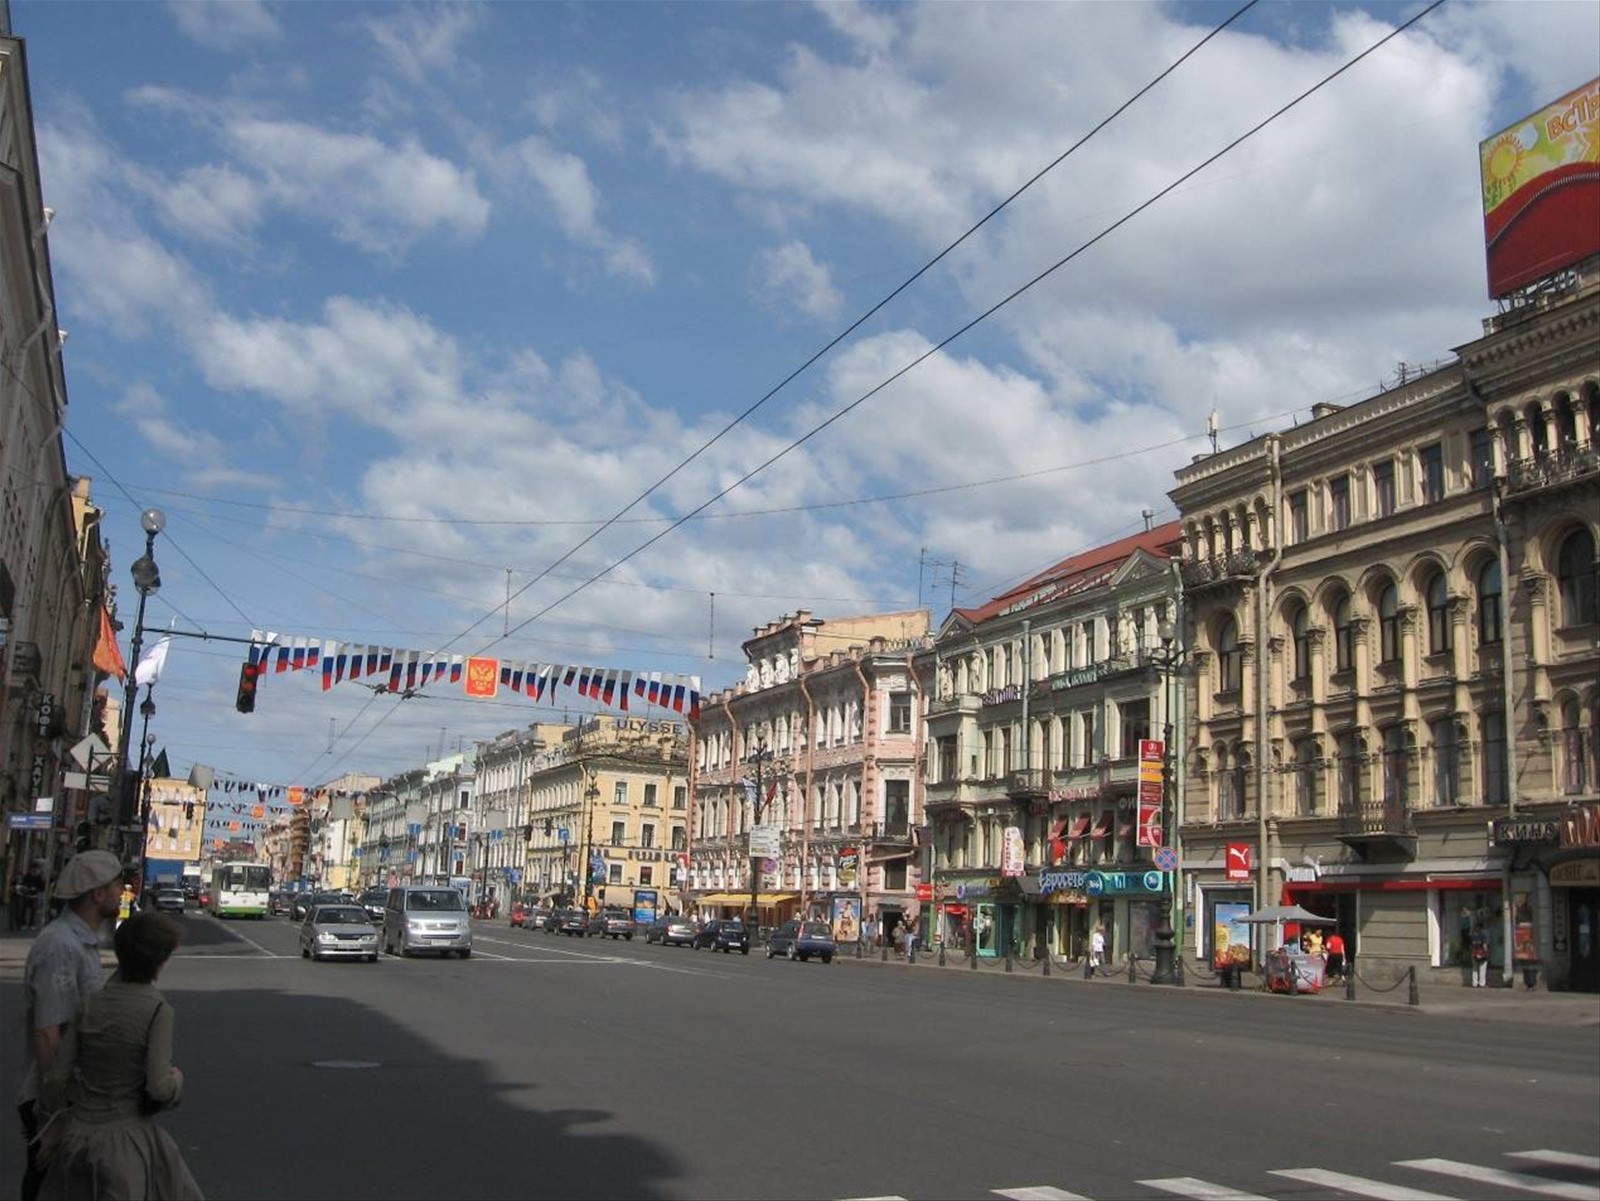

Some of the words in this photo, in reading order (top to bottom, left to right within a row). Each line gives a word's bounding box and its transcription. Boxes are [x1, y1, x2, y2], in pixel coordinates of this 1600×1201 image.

[39, 694, 52, 736] КОФЕ
[617, 718, 683, 735] ULYSSE
[1500, 822, 1557, 840] КИНО
